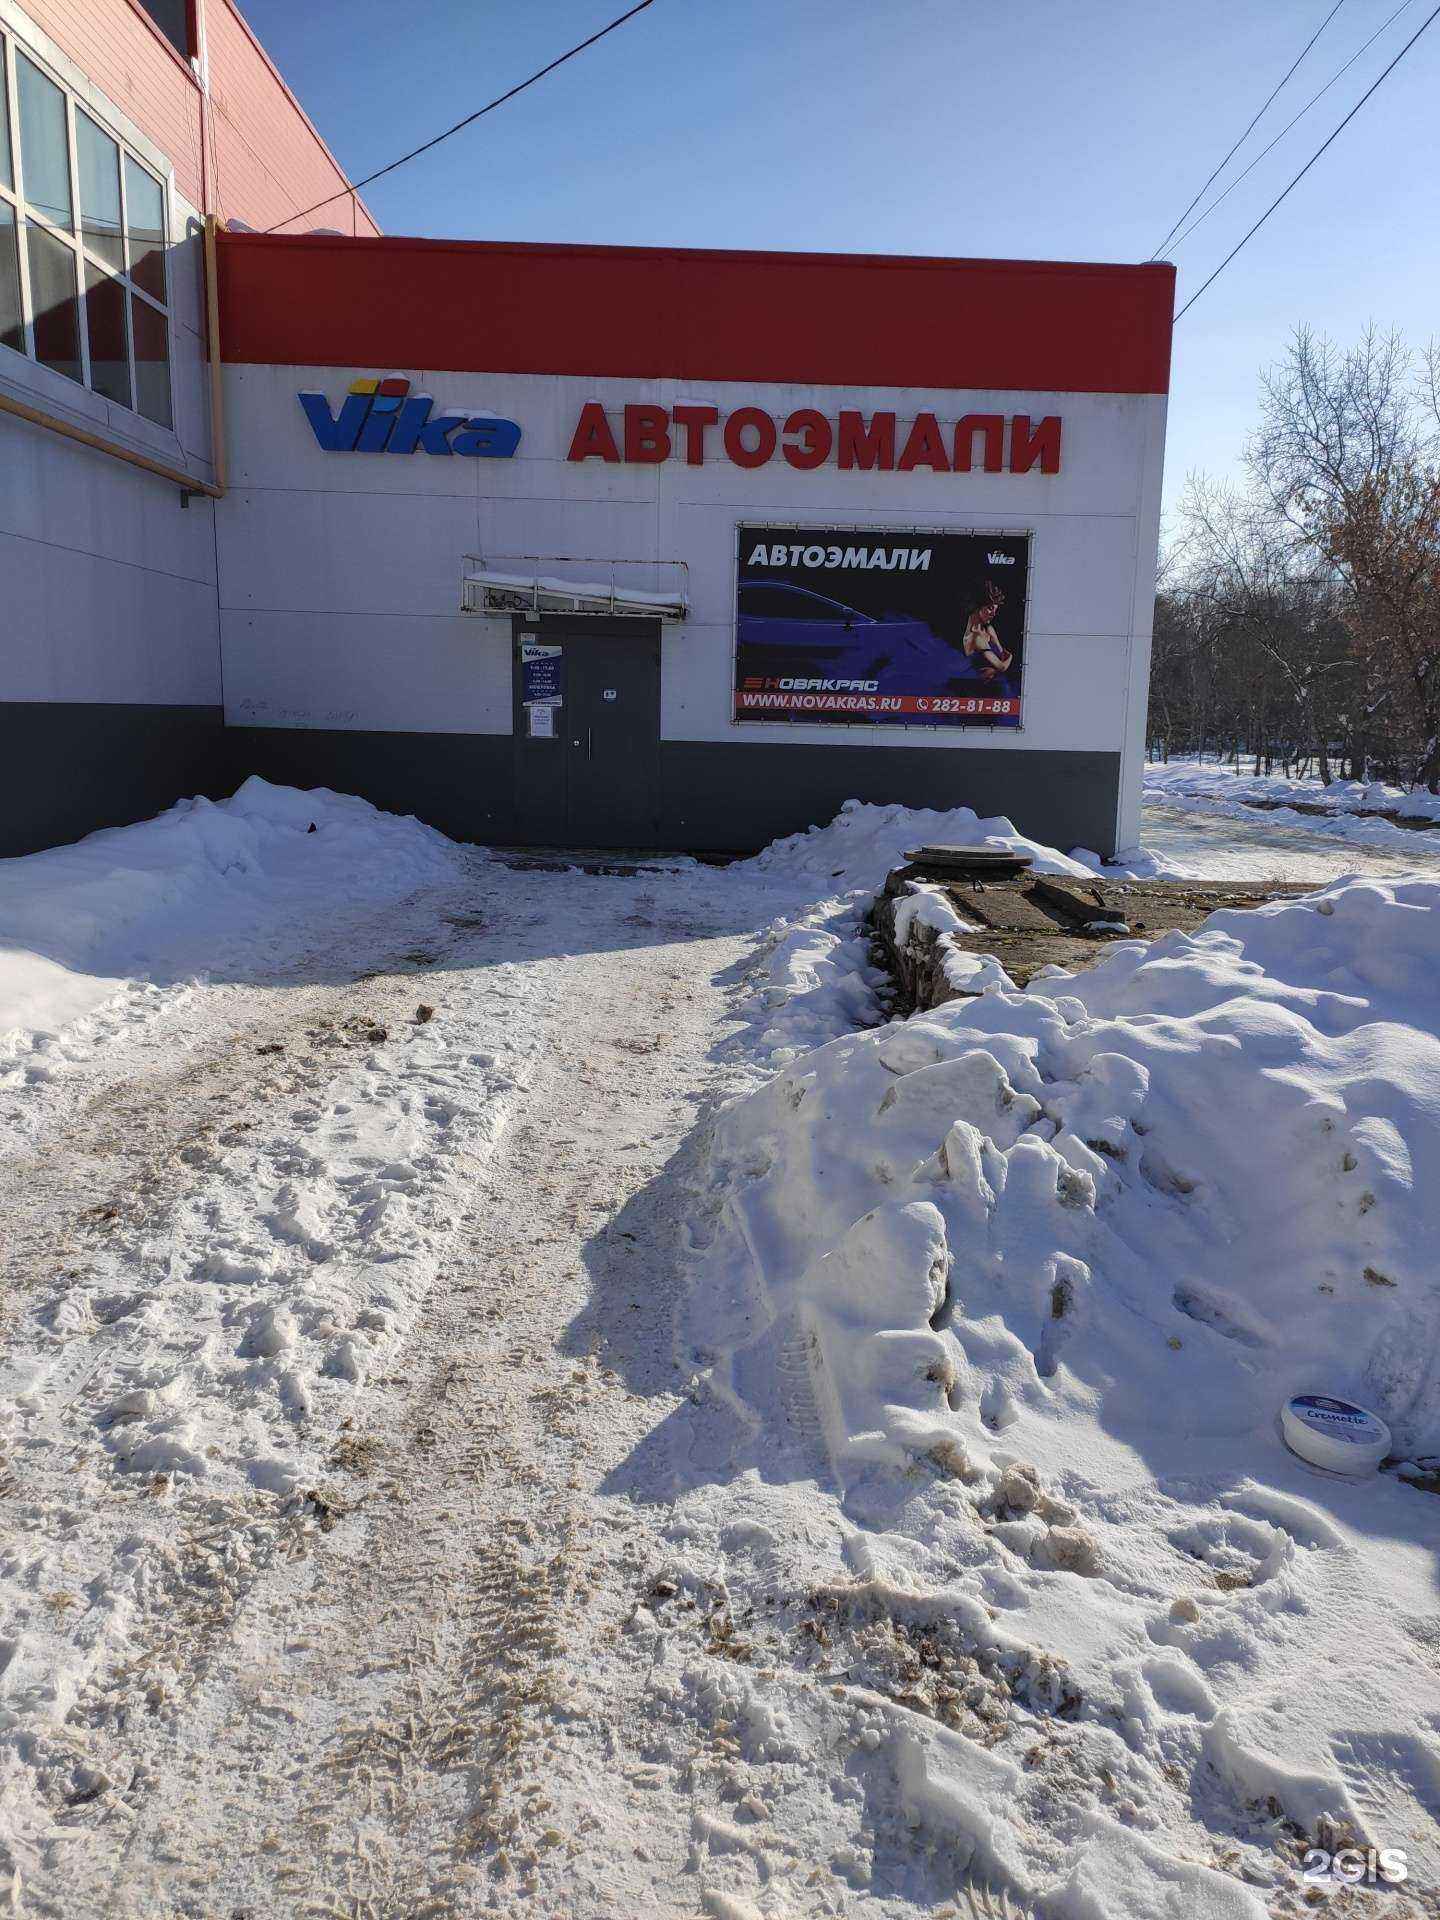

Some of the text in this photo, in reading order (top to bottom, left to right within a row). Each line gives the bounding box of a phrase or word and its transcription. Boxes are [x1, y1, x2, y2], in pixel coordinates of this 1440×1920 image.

[297, 375, 522, 458] Vika
[566, 401, 1063, 475] АВТОЭМАЛИ
[747, 543, 932, 571] АВТОЭМАЛИ
[987, 550, 1016, 565] Vika
[742, 694, 1011, 713] WWW.NOVAKRAS.RU 282-81-88
